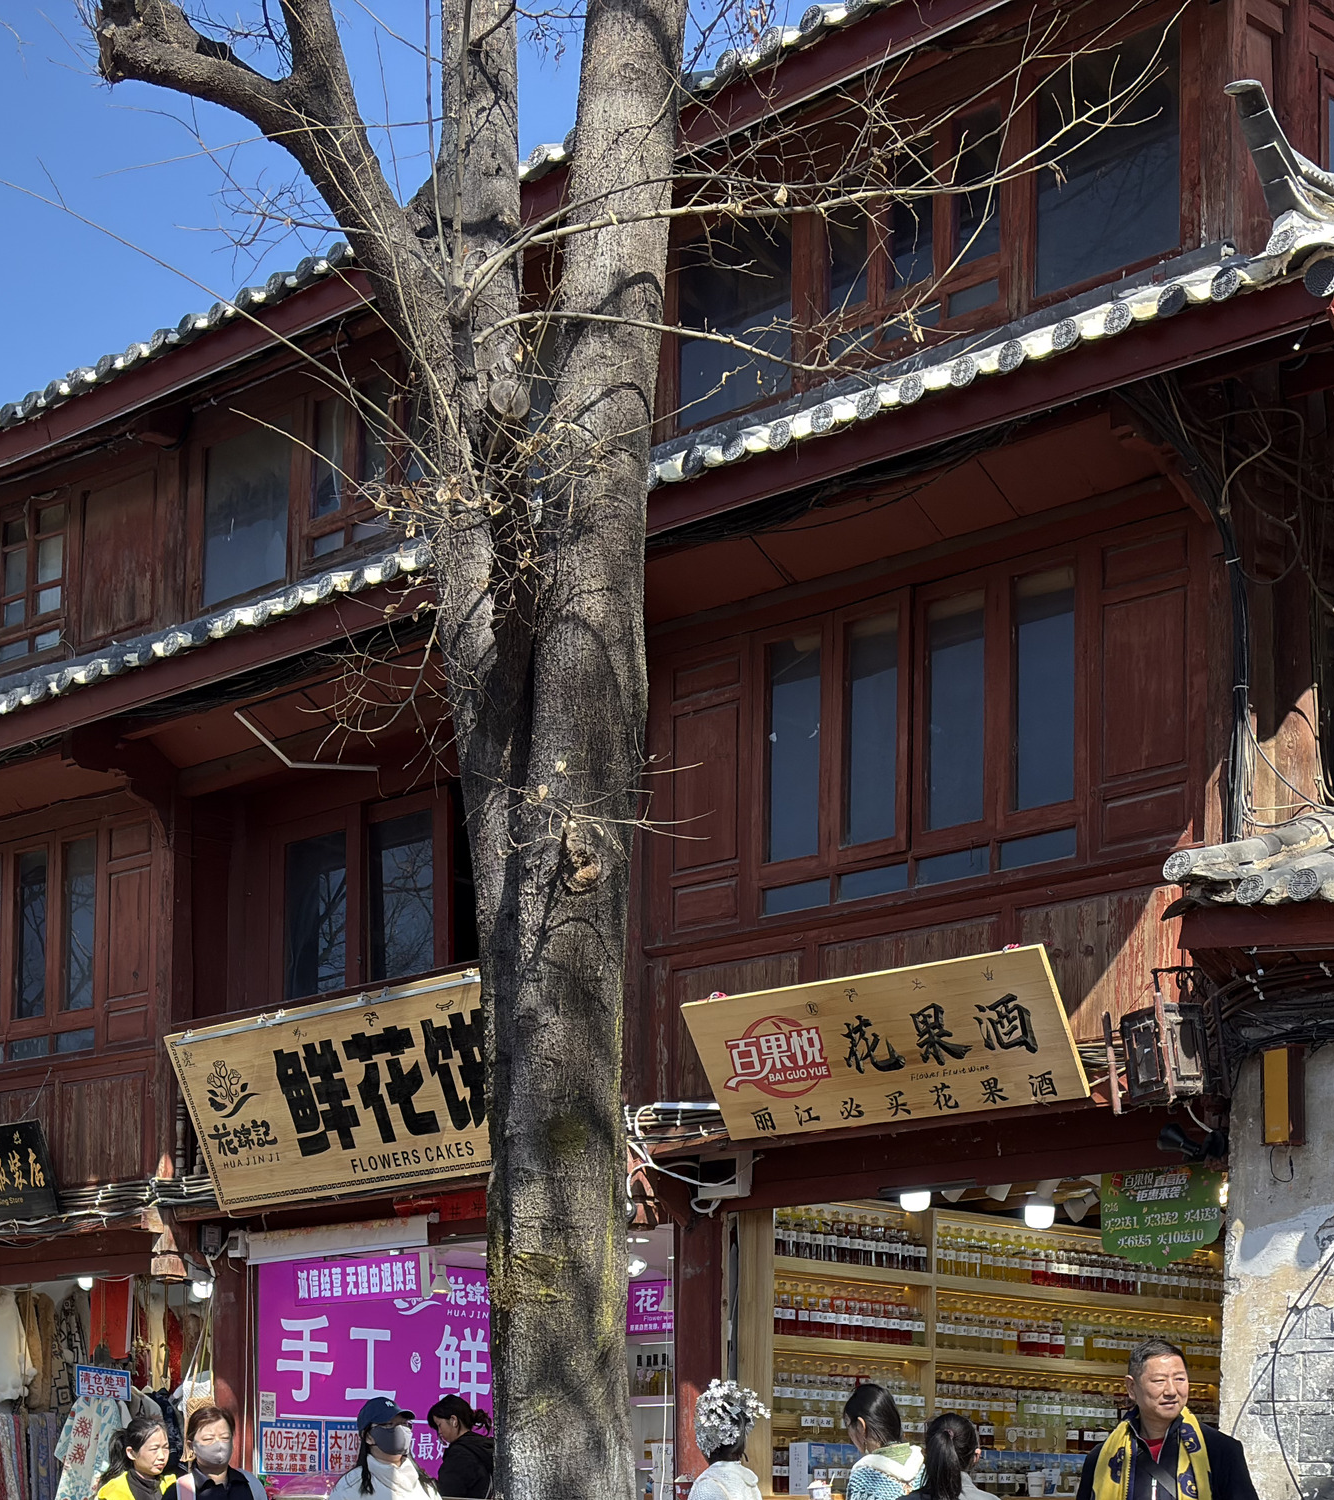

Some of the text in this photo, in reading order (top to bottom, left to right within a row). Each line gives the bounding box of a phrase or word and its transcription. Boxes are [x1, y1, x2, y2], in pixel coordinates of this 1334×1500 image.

[843, 992, 1039, 1074] 花果酒
[726, 1026, 827, 1076] 百果悦
[768, 1065, 829, 1083] BAI GUO YUE
[942, 1067, 966, 1077] Fruit
[751, 1069, 1058, 1132] 丽江必买花果酒
[351, 1141, 475, 1174] FLOWERS CAKES
[9, 1196, 23, 1205] Store
[297, 1260, 417, 1300] 诚信经营 无理由退换货
[446, 1276, 490, 1306] 花錦
[276, 1315, 397, 1402] 手工
[80, 1370, 127, 1388] 清仓处理
[87, 1384, 120, 1399] 59元
